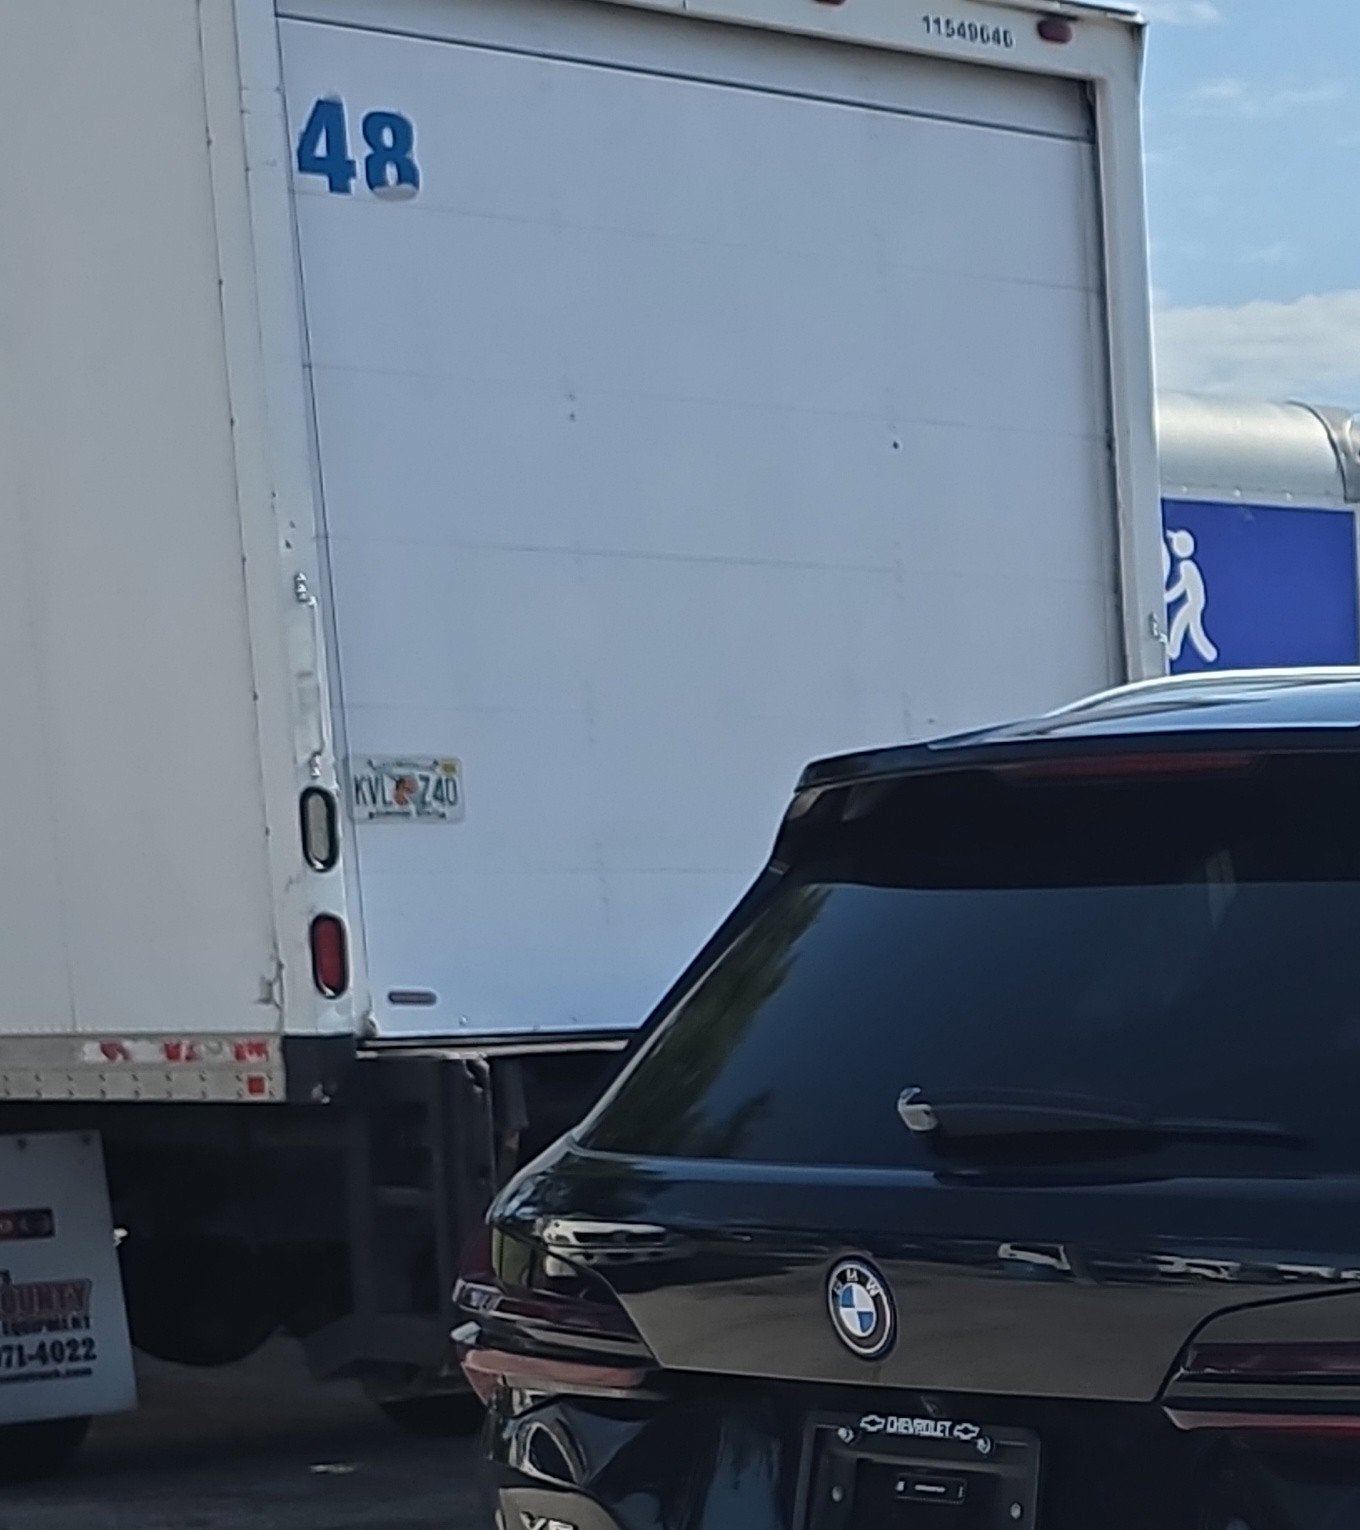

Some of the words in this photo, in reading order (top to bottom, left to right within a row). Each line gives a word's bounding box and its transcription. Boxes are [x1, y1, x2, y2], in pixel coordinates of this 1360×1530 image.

[298, 97, 420, 200] 48
[0, 1337, 97, 1369] 71-4022
[886, 1415, 953, 1439] CHEVROLET
